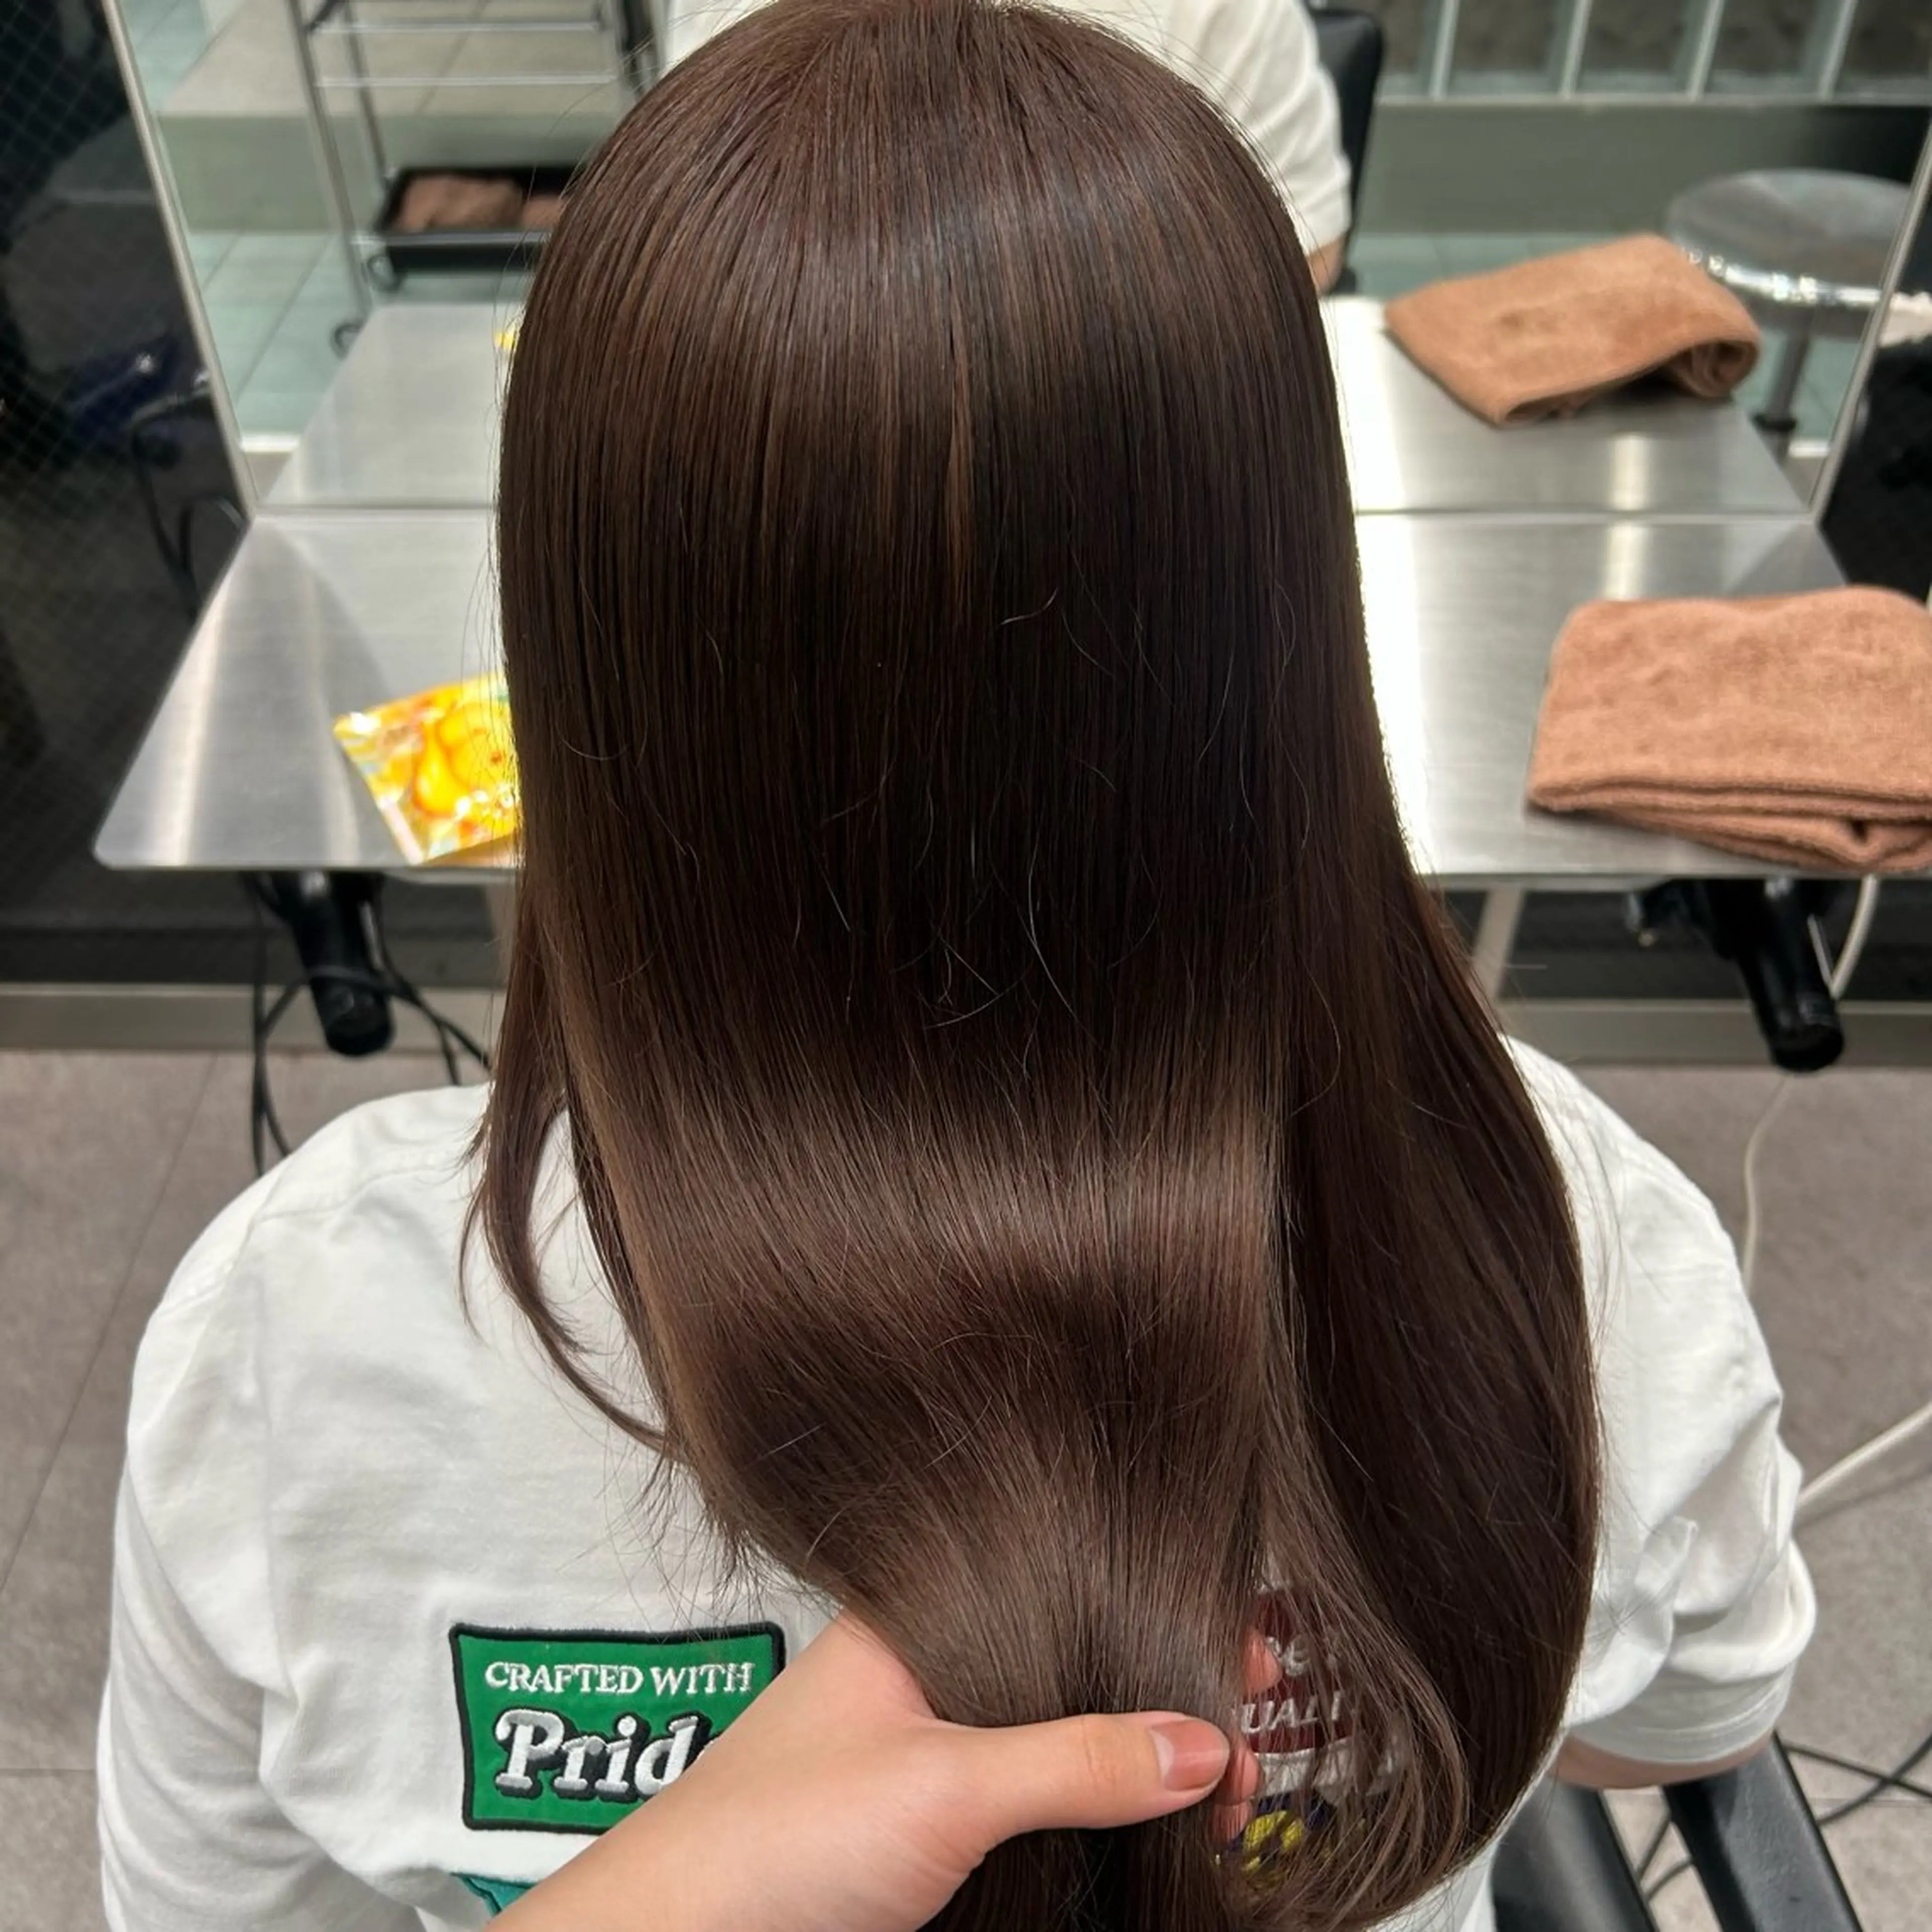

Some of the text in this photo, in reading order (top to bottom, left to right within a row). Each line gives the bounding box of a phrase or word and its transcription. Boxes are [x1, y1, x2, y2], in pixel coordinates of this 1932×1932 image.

[485, 1661, 756, 1697] CRAFTED WITH
[495, 1709, 716, 1796] Prid
